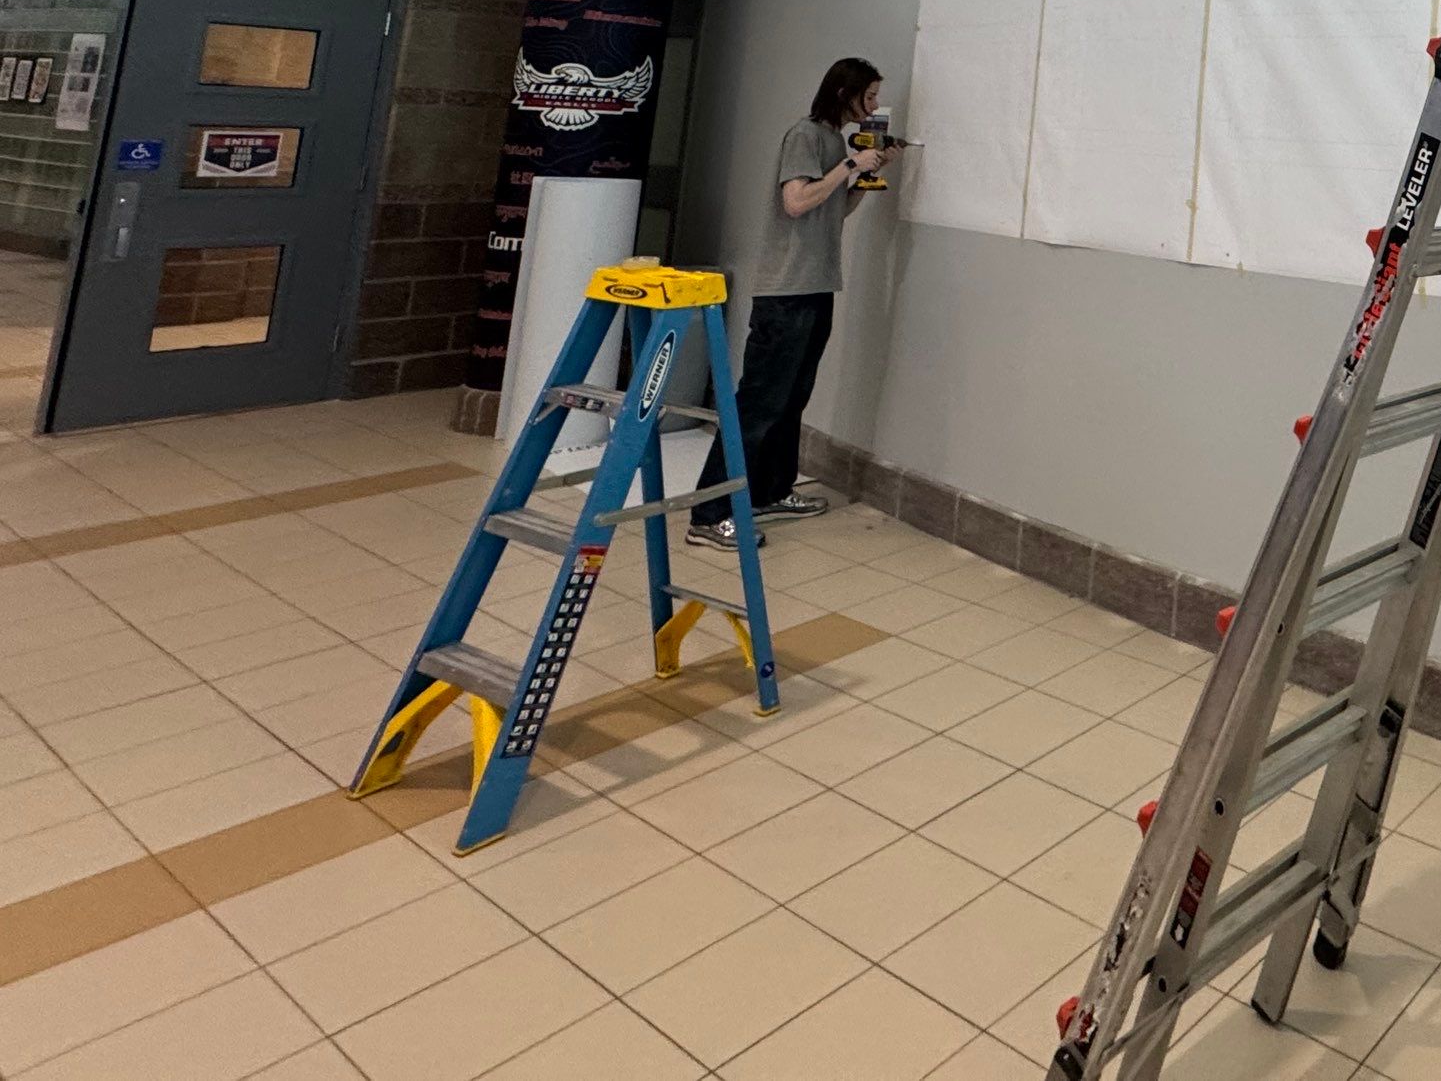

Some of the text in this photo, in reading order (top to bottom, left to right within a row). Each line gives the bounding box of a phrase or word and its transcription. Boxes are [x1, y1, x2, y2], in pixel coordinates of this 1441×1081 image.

[529, 83, 622, 98] LIBERTY
[224, 137, 263, 146] ENTER
[1396, 147, 1433, 231] LEVELER
[612, 287, 640, 297] WERNER
[645, 348, 670, 402] WERNER
